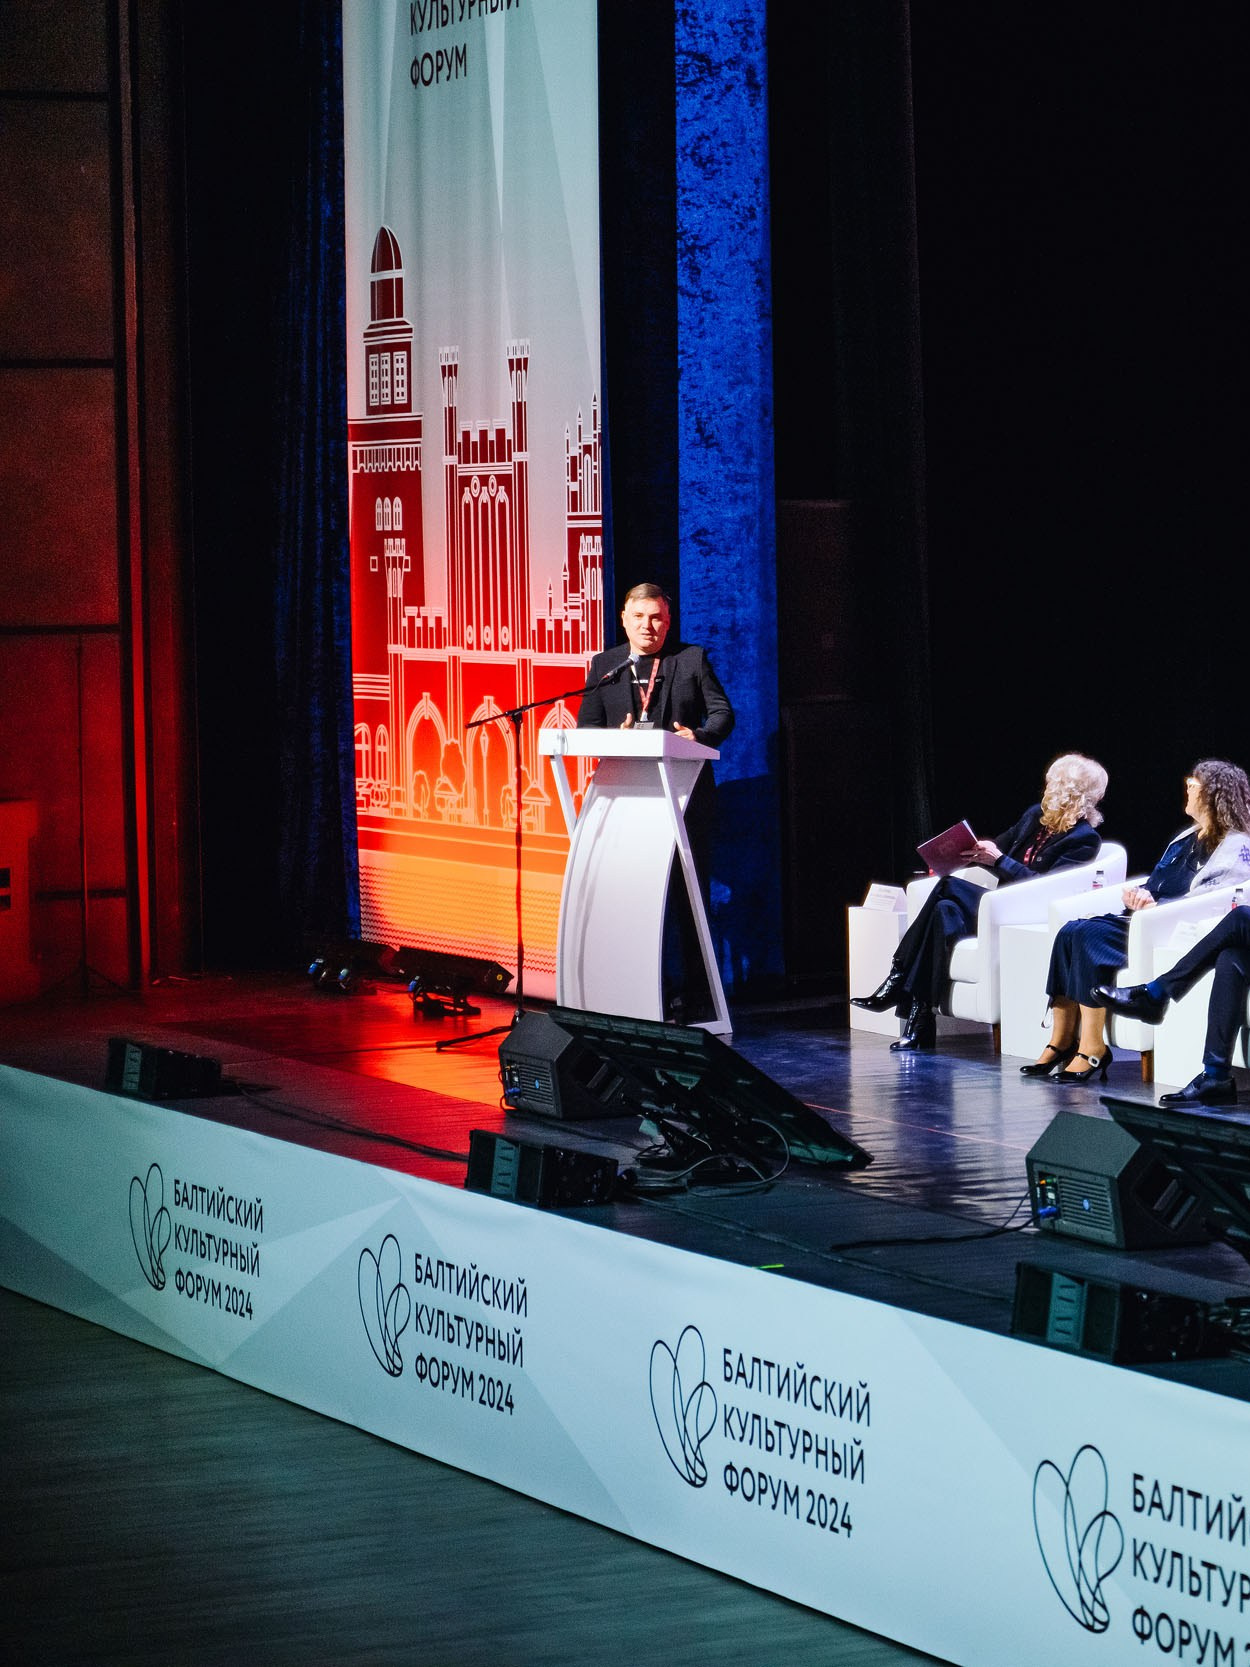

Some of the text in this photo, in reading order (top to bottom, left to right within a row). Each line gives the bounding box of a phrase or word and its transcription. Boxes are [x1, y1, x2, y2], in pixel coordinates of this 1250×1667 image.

[410, 43, 467, 89] ФОРУМ
[174, 1179, 264, 1234] БАЛТИЙСКИЙ
[174, 1223, 260, 1278] КУЛЬТУРНЫЙ
[174, 1267, 253, 1321] ФОРУМ 2024
[415, 1253, 528, 1318] БАЛТИЙСКИЙ
[415, 1302, 524, 1368] КУЛЬТУРНЫЙ
[415, 1352, 514, 1415] ФОРУМ 2024
[723, 1348, 871, 1427] БАЛТИЙСКИЙ
[723, 1404, 865, 1485] КУЛЬТУРНЫЙ
[723, 1461, 852, 1538] ФОРУМ 2024
[1132, 1605, 1235, 1667] ФОРУМ
